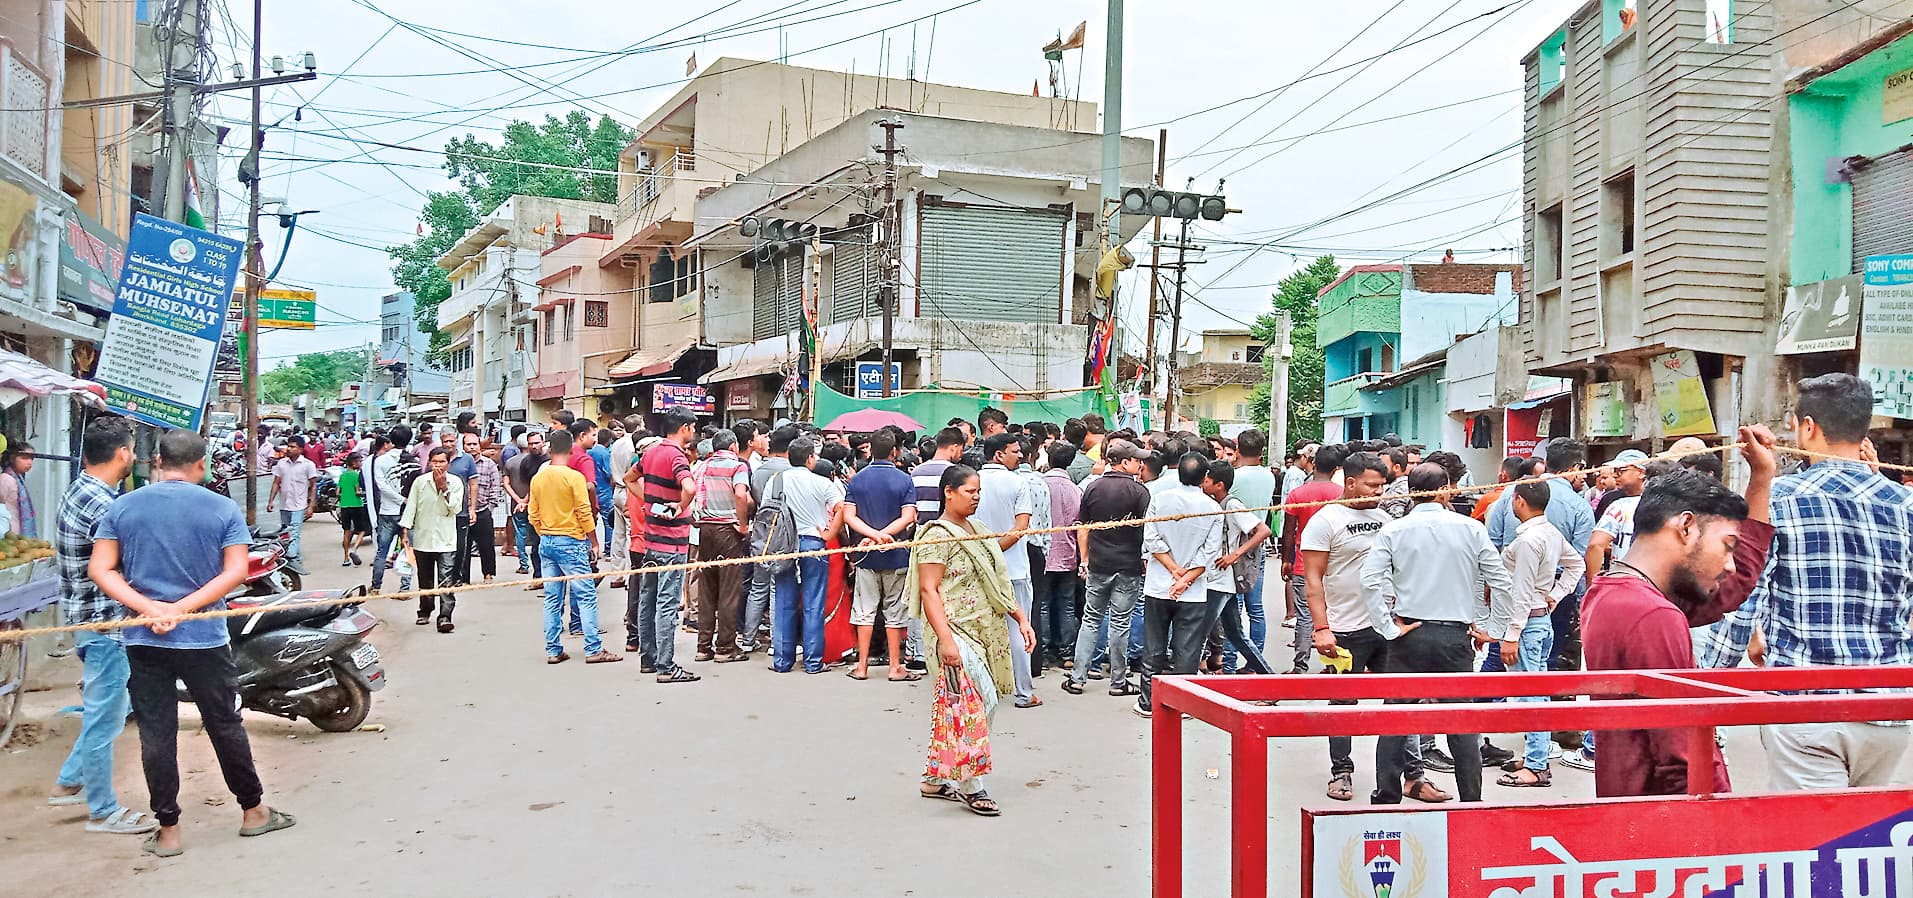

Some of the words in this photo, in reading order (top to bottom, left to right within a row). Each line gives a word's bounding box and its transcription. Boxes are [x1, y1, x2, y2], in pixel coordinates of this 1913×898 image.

[127, 263, 165, 279] Residential
[166, 274, 182, 283] Girls
[1867, 260, 1889, 272] SONY
[125, 271, 219, 308] JAMIATUL
[117, 286, 220, 325] MUHSENAT
[1363, 830, 1376, 839] सेवा
[1377, 830, 1385, 839] ही
